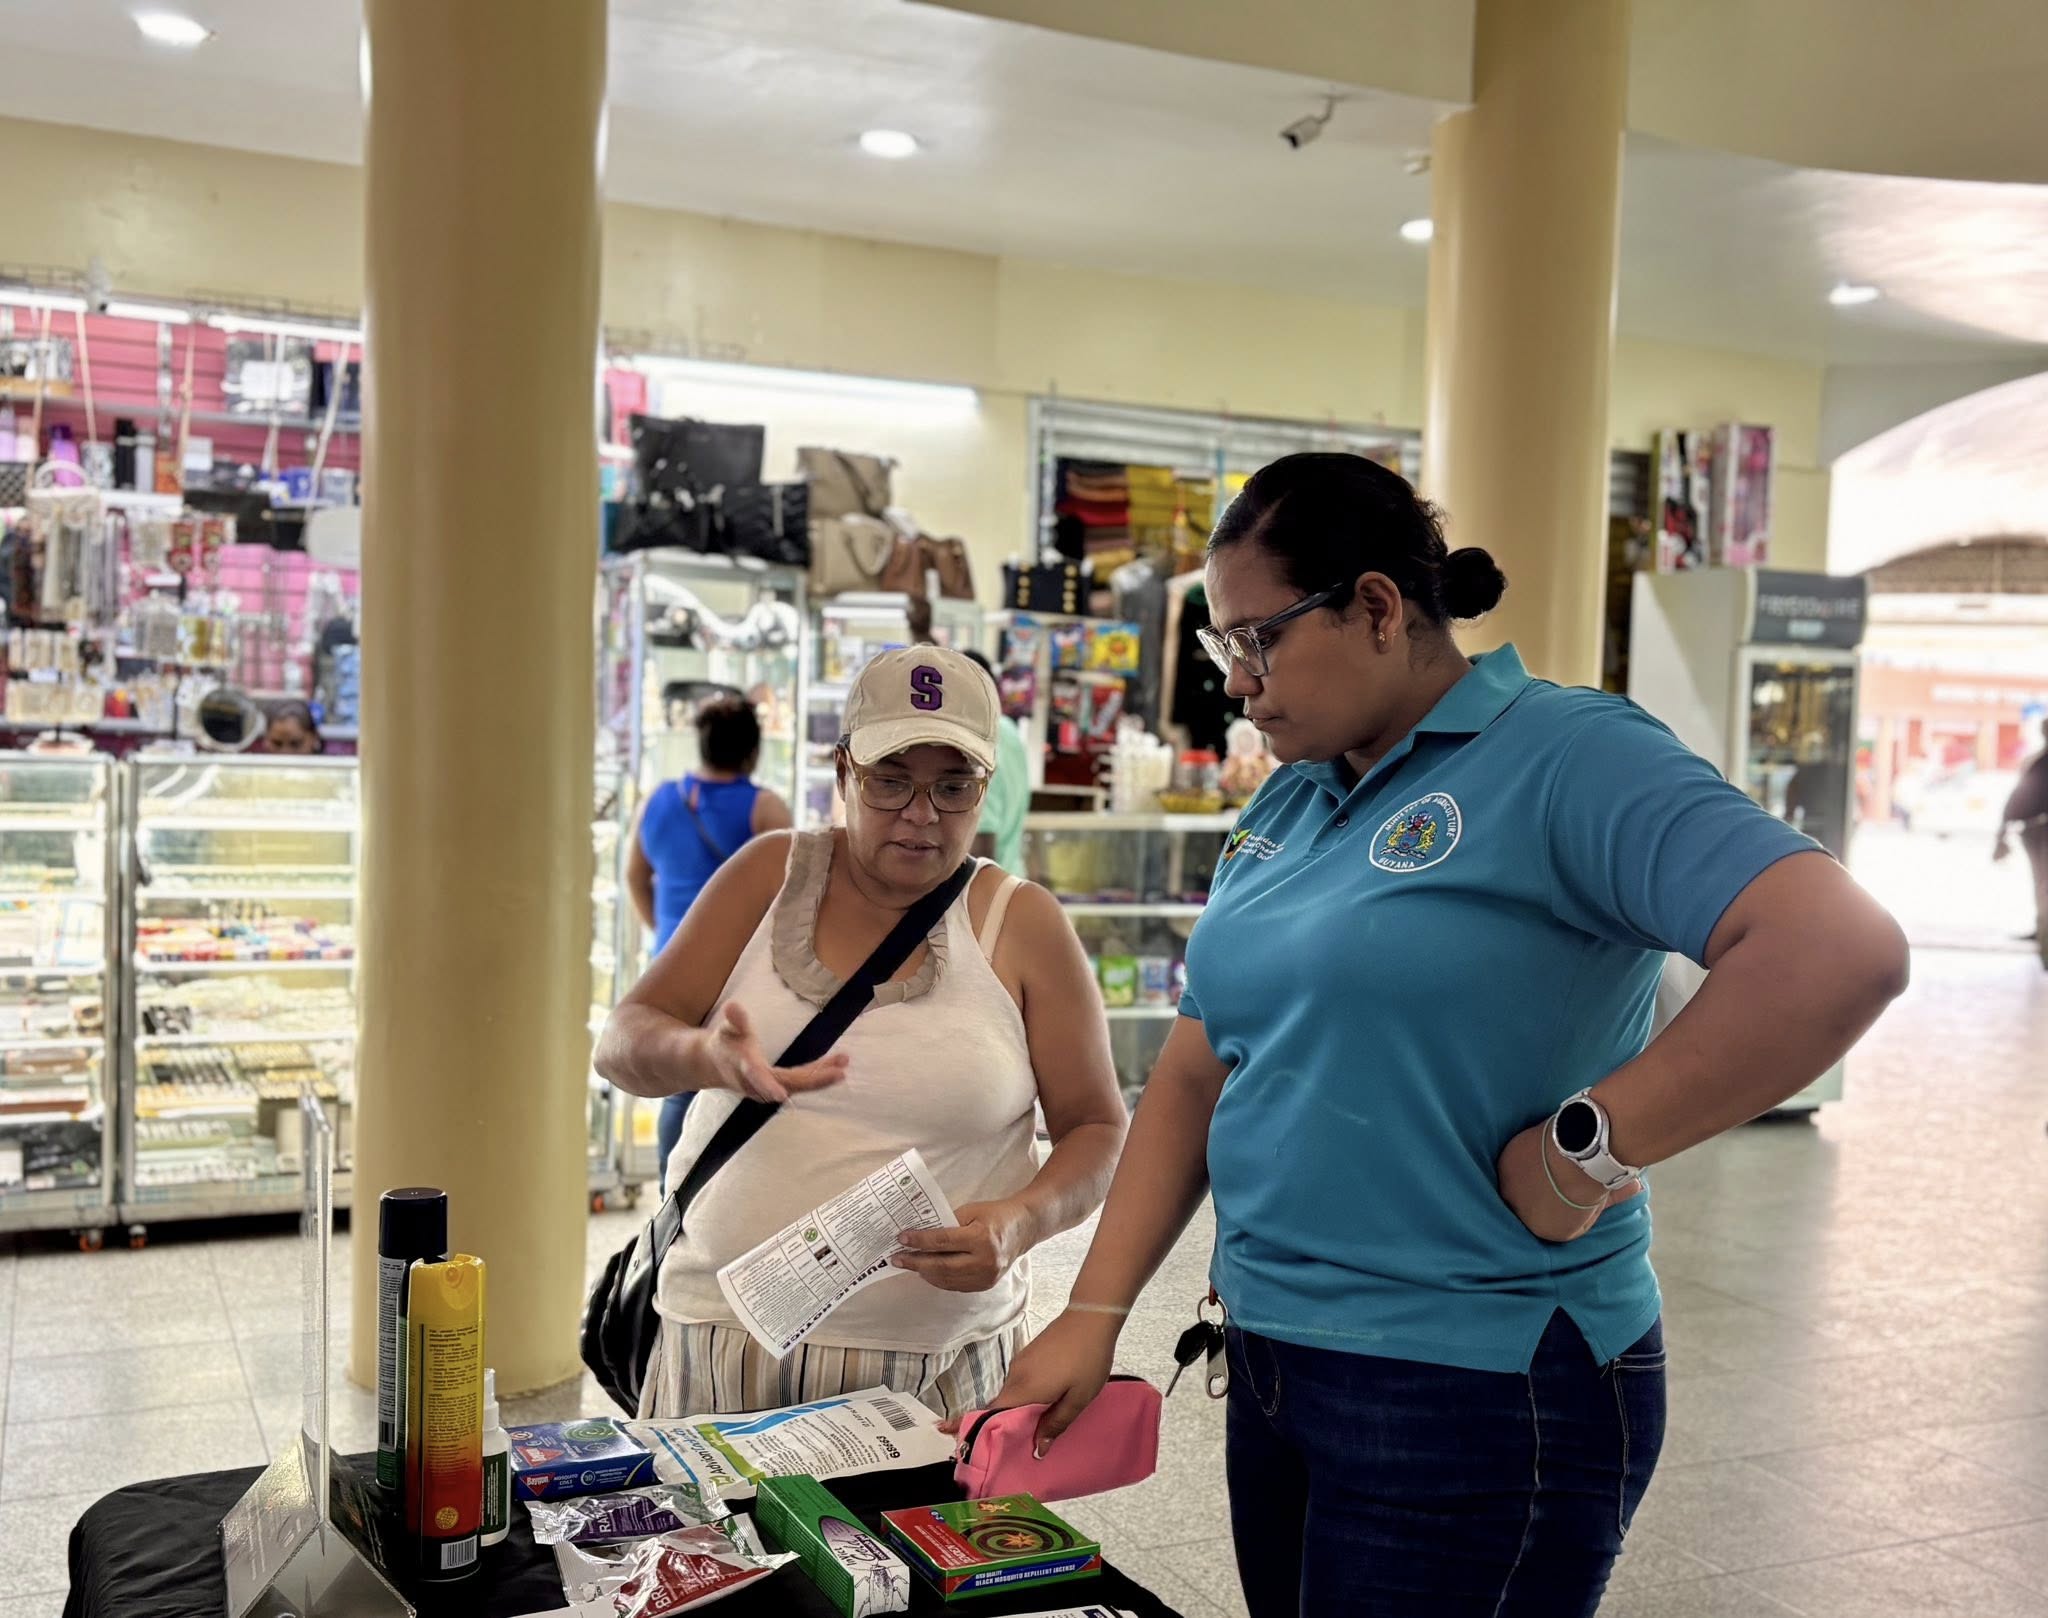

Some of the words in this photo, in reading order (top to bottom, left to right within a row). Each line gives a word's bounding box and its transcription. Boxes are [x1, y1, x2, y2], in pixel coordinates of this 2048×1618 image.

[910, 665, 943, 711] S
[1378, 857, 1415, 868] GUYANA
[835, 1259, 888, 1301] PUBLIC
[783, 1303, 834, 1350] NOTICE
[699, 1451, 726, 1474] Advion
[975, 1578, 993, 1587] BLACK
[994, 1573, 1023, 1583] MOSQUITO
[1024, 1568, 1052, 1579] REPELLENT
[1053, 1564, 1076, 1574] INCENSE
